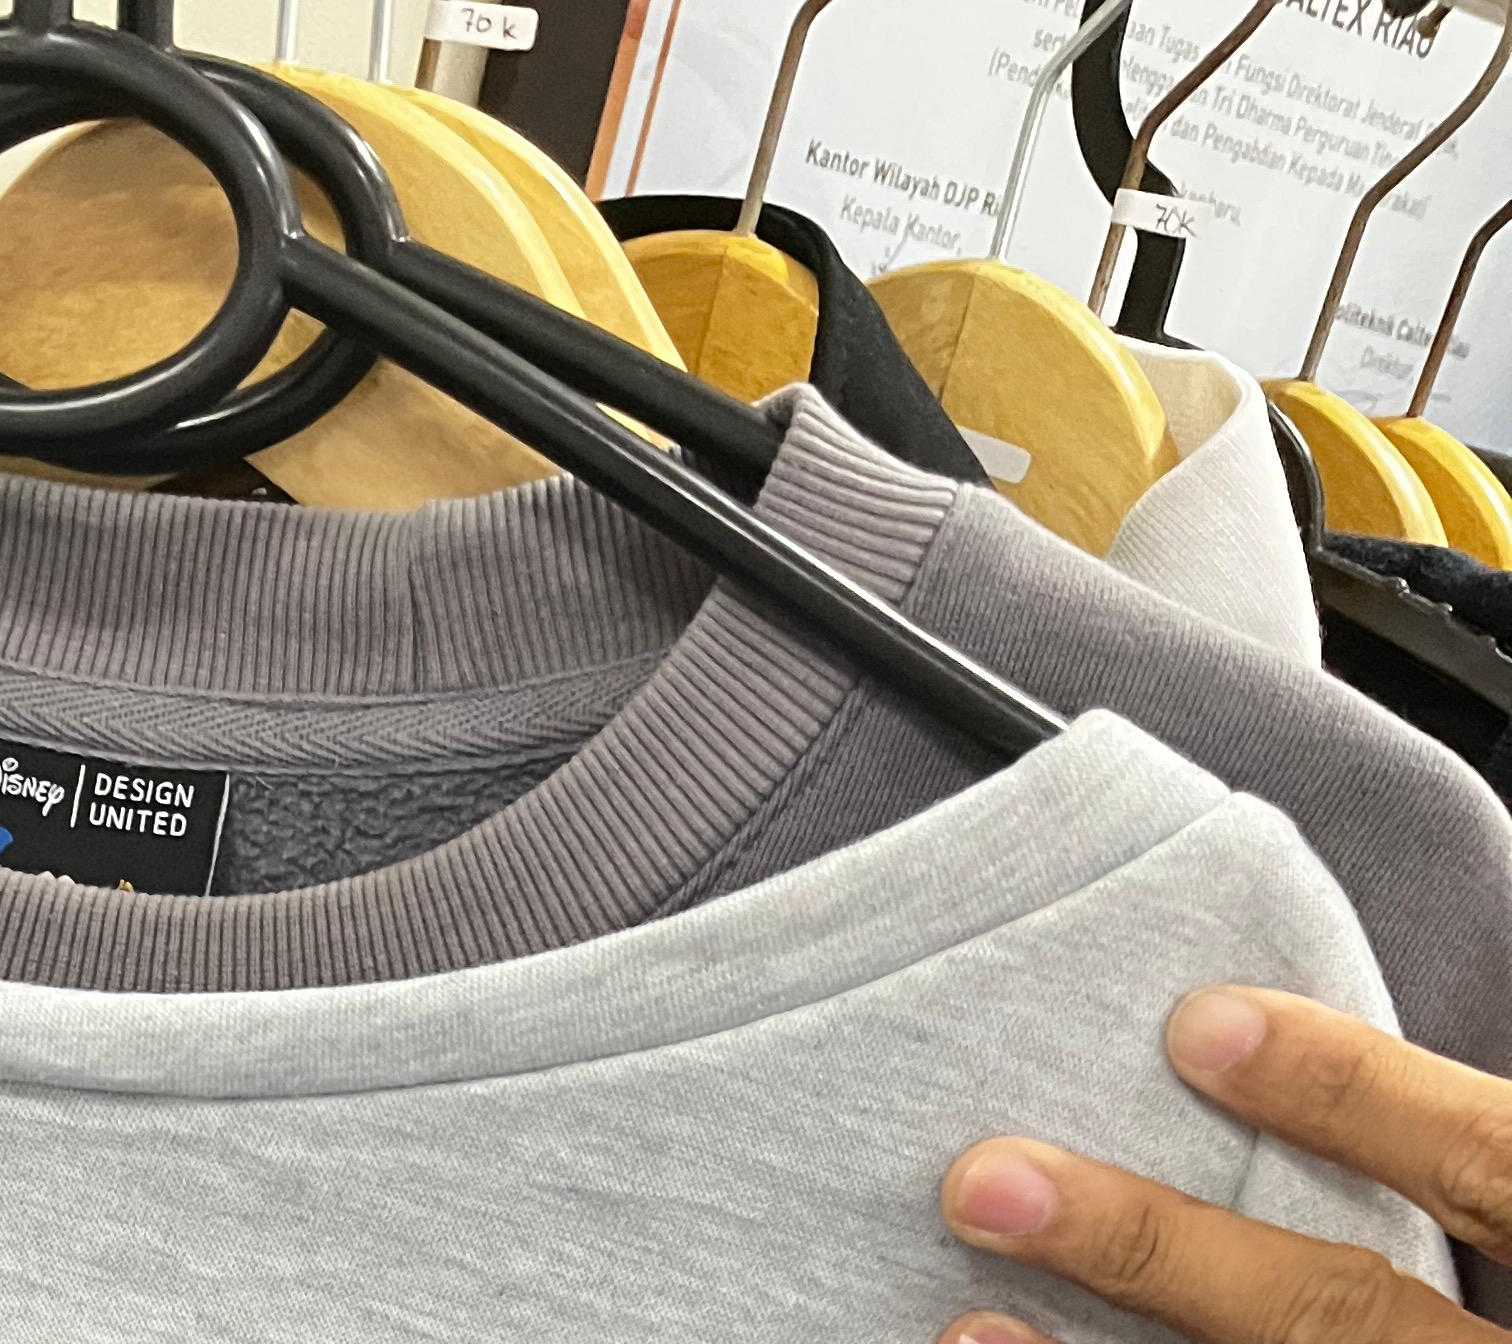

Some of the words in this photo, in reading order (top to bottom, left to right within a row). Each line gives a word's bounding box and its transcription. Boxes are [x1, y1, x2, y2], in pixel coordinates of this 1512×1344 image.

[461, 7, 492, 34] 70
[1234, 53, 1287, 95] Fungsi
[1286, 71, 1361, 120] Direktorat
[1235, 93, 1293, 135] Dharma
[804, 138, 870, 180] Kantor
[872, 156, 941, 201] Wilayah
[943, 180, 980, 210] DJP
[839, 194, 900, 236] Kepala
[93, 772, 195, 809] DESIGN
[87, 802, 188, 838] UNITED
